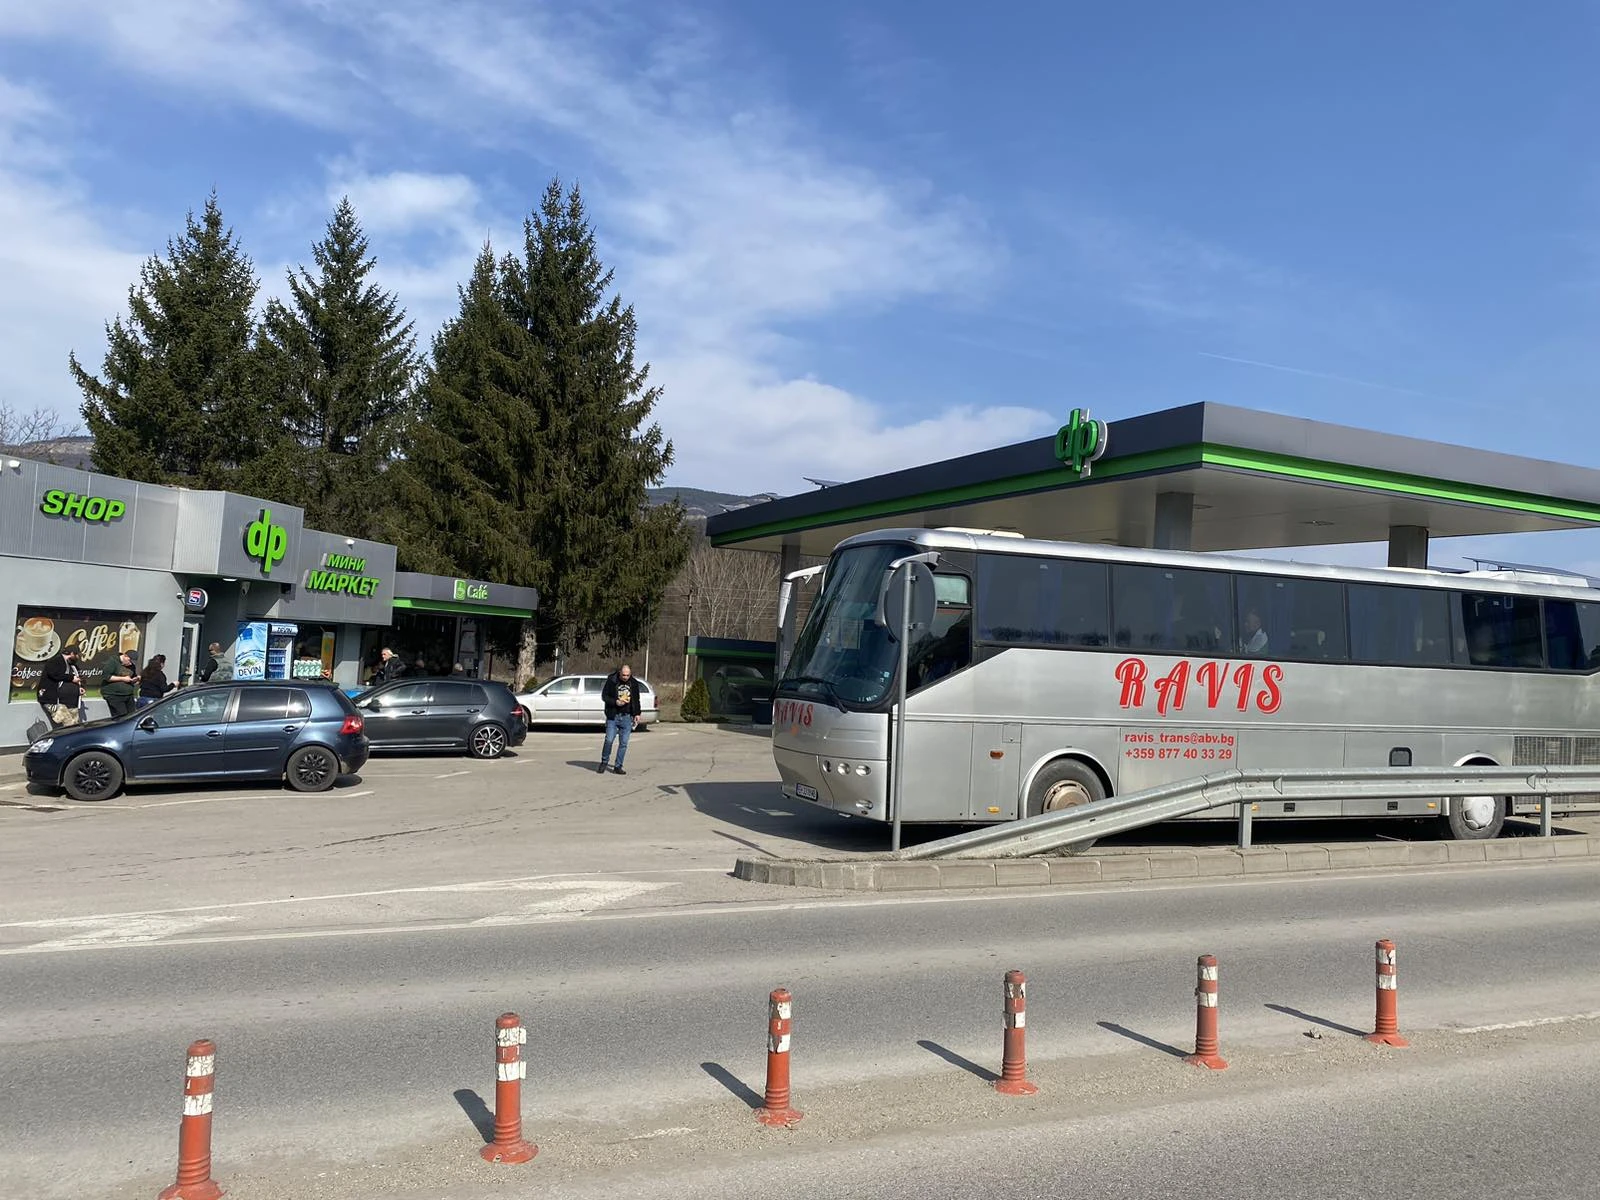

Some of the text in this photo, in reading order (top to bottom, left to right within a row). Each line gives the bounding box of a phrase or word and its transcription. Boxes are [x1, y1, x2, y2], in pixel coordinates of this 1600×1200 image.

[1056, 408, 1100, 474] dp
[42, 489, 126, 523] SHOP
[244, 508, 288, 573] dp
[326, 553, 366, 572] МИНИ
[306, 569, 380, 596] МАРКЕТ
[467, 584, 488, 600] Café
[65, 624, 118, 662] Coffee
[12, 667, 42, 679] Coffee
[238, 666, 262, 677] DEVIN
[1115, 657, 1284, 717] RAVIS
[1124, 732, 1235, 746] ravis_trans@abv.bg
[1125, 748, 1232, 760] +359 877 40 33 29
